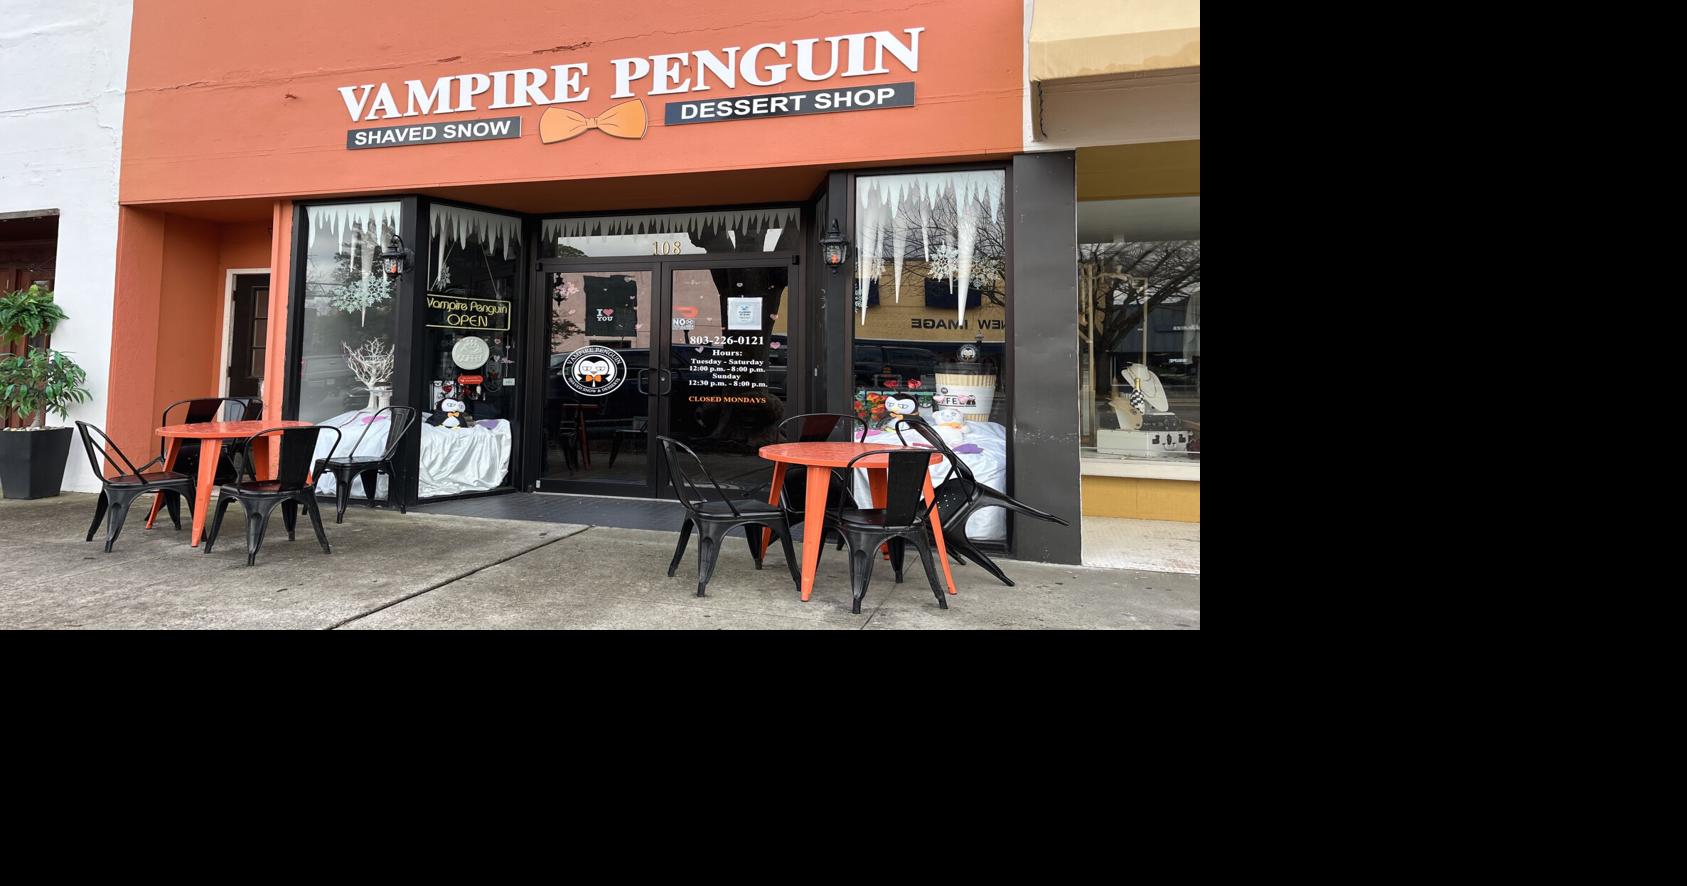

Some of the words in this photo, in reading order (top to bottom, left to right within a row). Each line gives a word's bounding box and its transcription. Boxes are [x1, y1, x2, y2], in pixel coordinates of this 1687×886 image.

[338, 62, 590, 121] VAMPIRE
[610, 27, 925, 99] PENGUIN
[680, 94, 807, 121] DESSERT
[813, 86, 896, 108] SHOP
[354, 123, 440, 146] SHAVED
[443, 120, 512, 139] SNOW
[652, 240, 681, 256] 108
[426, 297, 468, 313] Vampire
[470, 301, 508, 315] Penguin
[596, 308, 603, 316] I
[447, 313, 488, 327] OPEN
[689, 336, 764, 345] 803-226-0121
[567, 348, 594, 365] VAMPIRE
[595, 348, 622, 365] PENGUIN
[724, 396, 766, 404] MONDAYS
